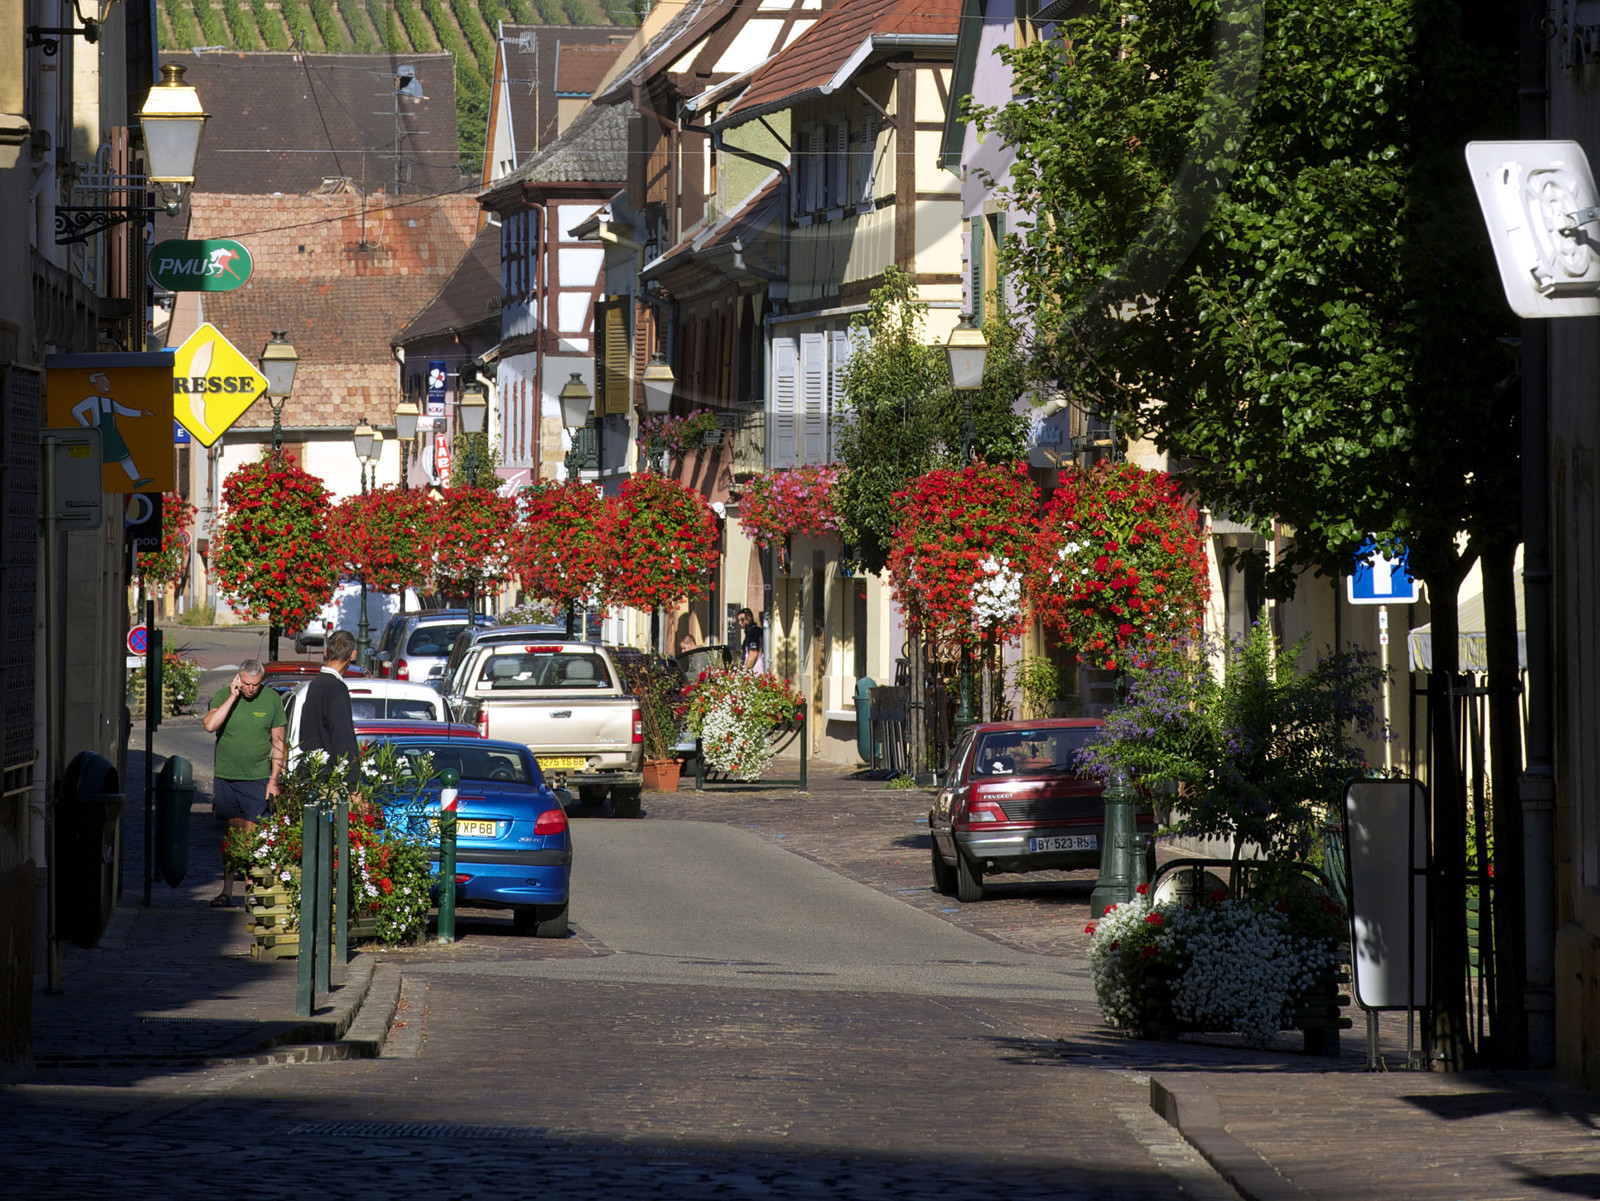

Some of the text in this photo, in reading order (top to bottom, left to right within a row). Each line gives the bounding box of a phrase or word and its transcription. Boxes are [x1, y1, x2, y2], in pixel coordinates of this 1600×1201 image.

[158, 258, 208, 275] PMU
[174, 376, 254, 393] RESSE
[437, 437, 450, 489] TABAC
[574, 757, 584, 766] 68
[463, 822, 477, 833] XP
[479, 823, 493, 834] 68
[1038, 837, 1090, 850] BY-523-RS
